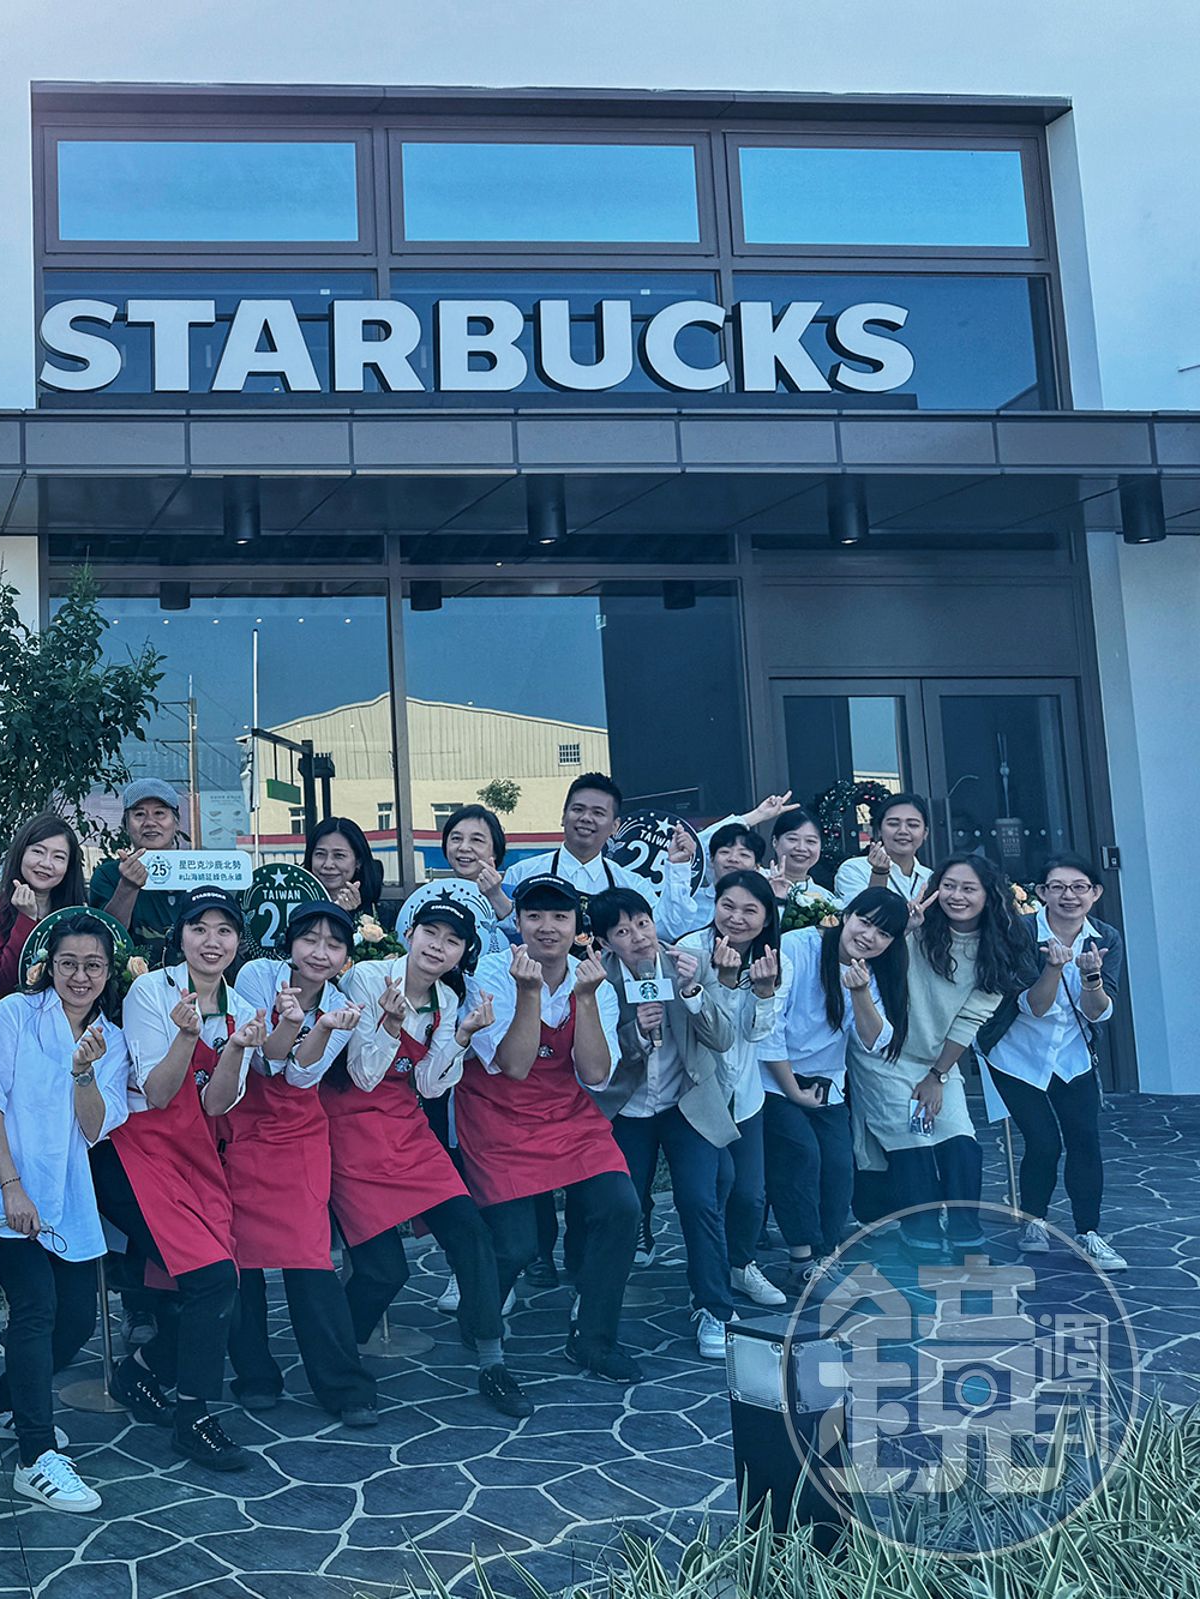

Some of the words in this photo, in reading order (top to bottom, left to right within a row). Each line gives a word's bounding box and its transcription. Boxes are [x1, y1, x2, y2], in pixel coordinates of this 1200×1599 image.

[38, 299, 915, 393] STARBUCKS
[640, 829, 670, 848] TAIWA
[151, 863, 167, 876] 25
[262, 889, 300, 900] TAIWAN
